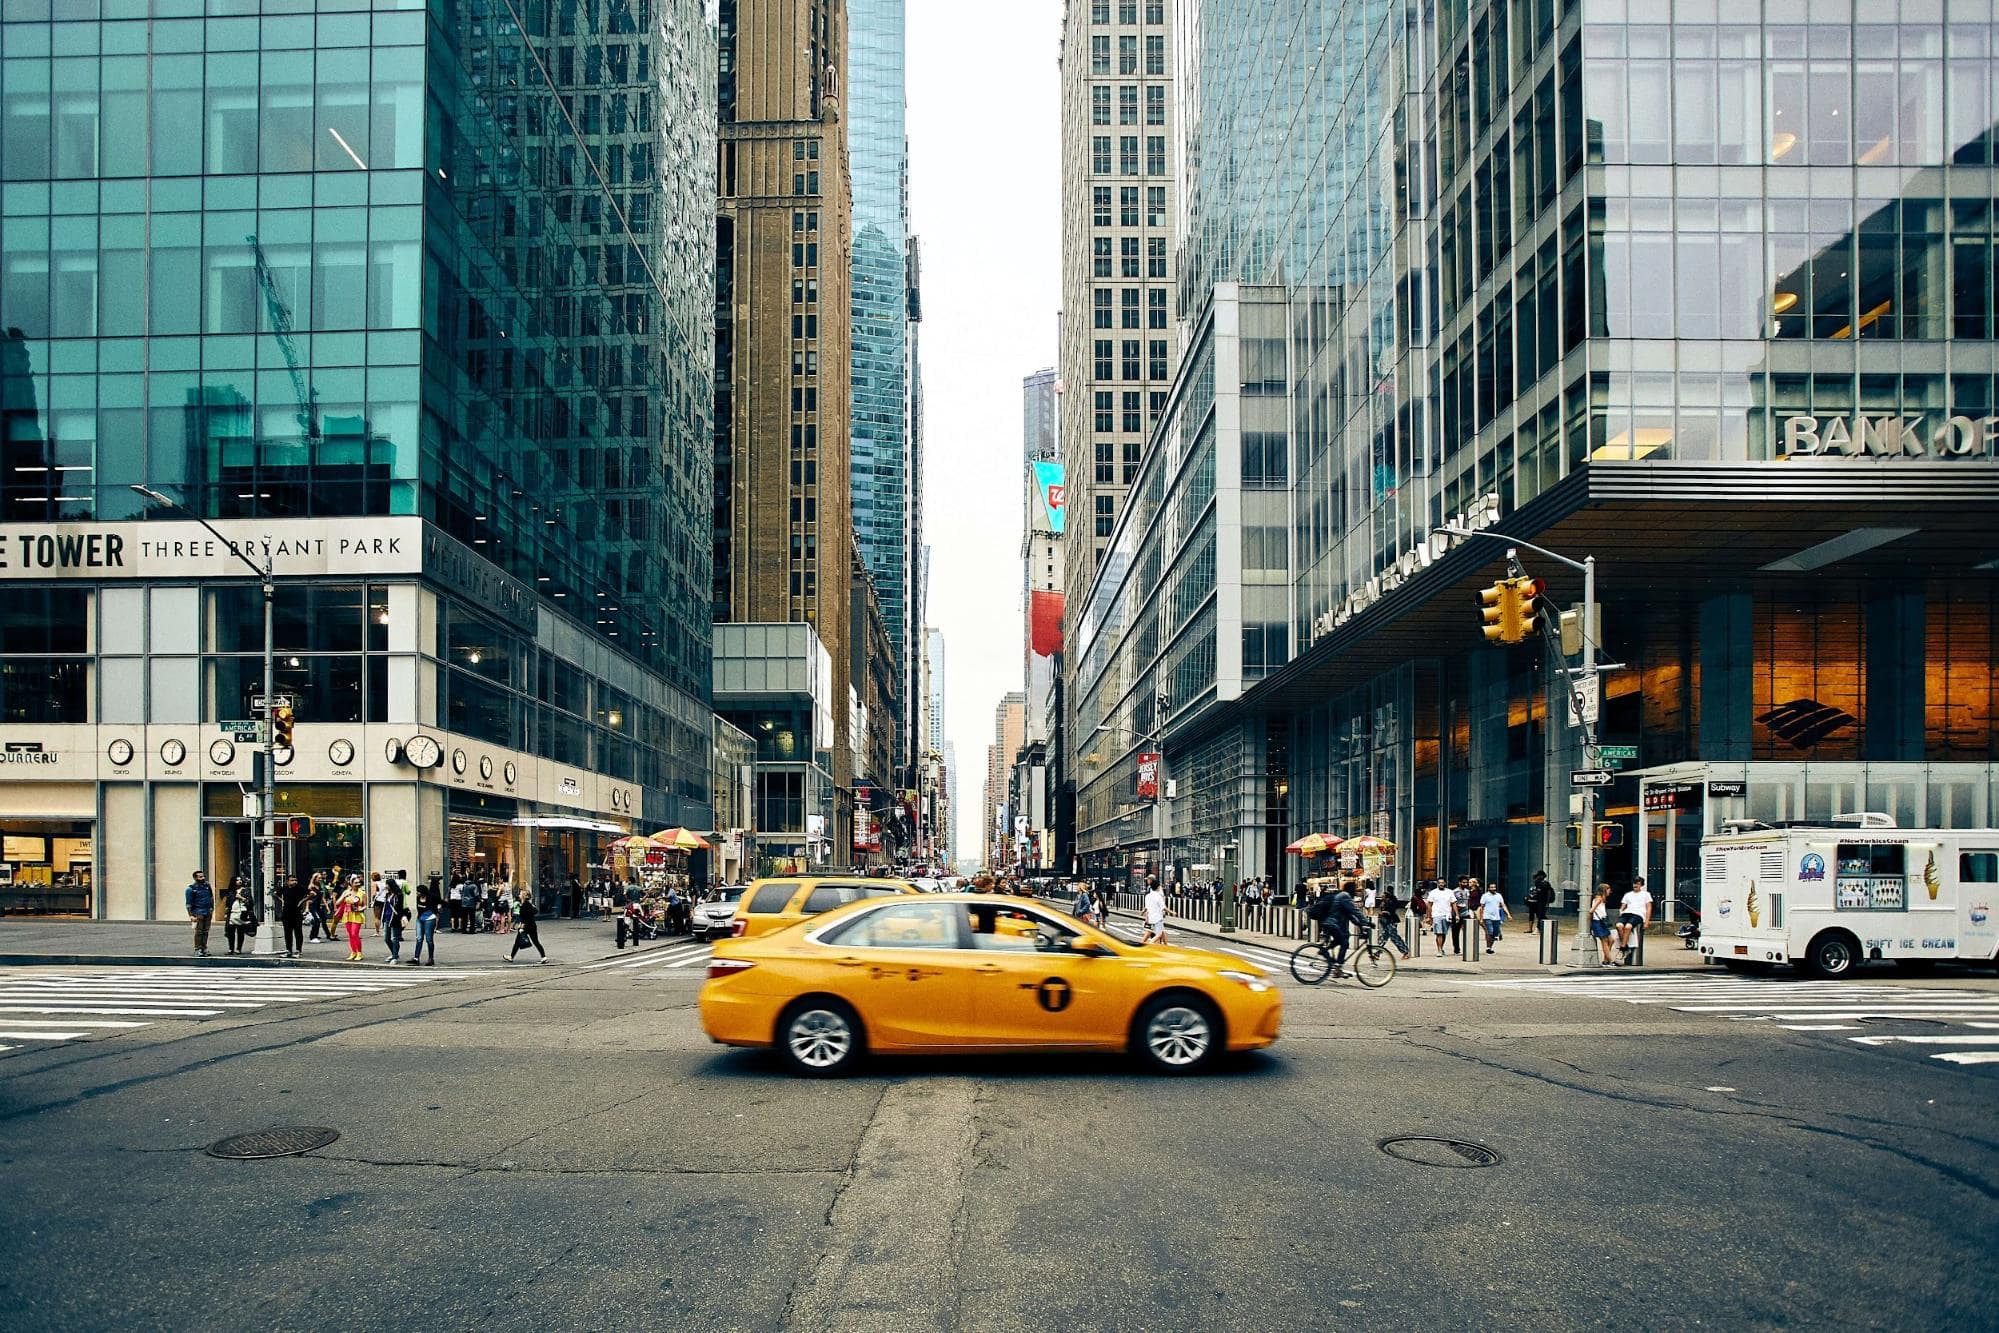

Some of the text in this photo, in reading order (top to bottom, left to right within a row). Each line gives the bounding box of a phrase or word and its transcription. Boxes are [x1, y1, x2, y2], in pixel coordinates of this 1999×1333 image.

[1785, 415, 1999, 456] BANK OF
[0, 534, 123, 568] E TOWER
[142, 537, 401, 557] THREE BRYANT PARK
[238, 734, 245, 742] 6
[1604, 760, 1611, 768] 6
[1710, 783, 1741, 792] Subway
[1900, 939, 1914, 948] ICE
[1921, 938, 1955, 949] CREAM
